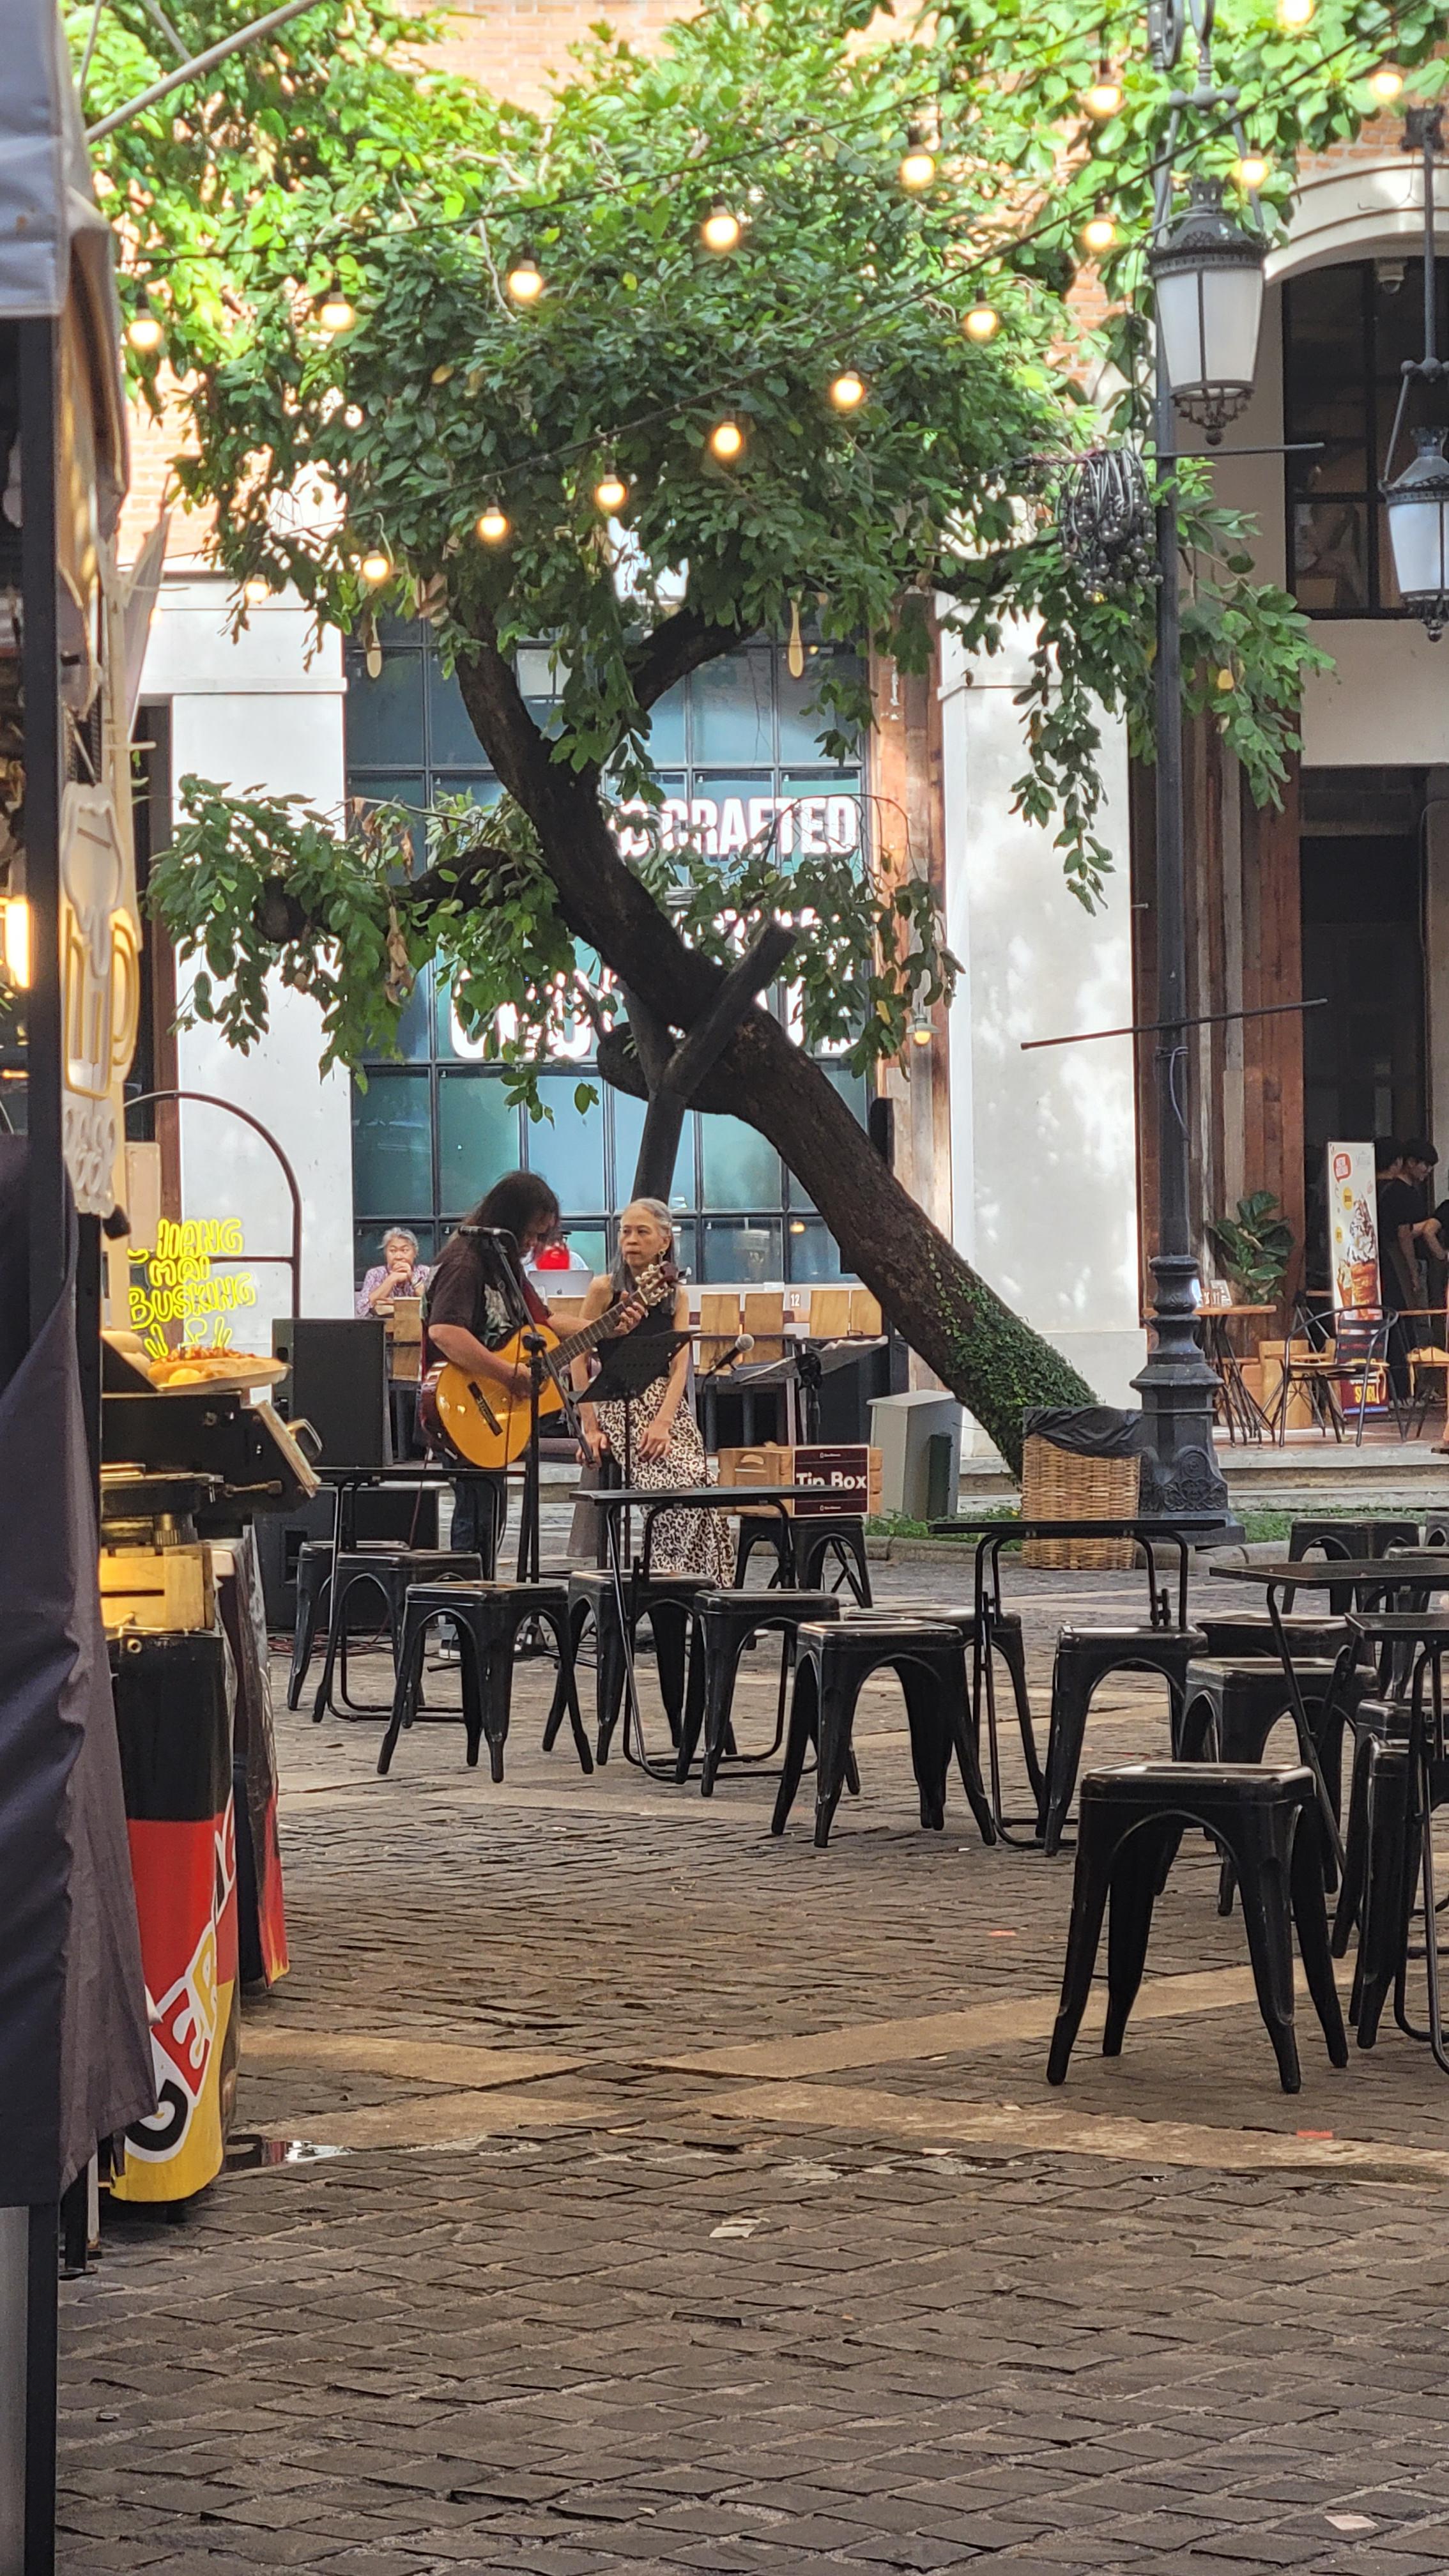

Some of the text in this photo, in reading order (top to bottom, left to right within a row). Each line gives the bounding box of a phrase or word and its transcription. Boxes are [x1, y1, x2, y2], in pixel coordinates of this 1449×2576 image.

[661, 797, 857, 855] CRAFTED
[149, 1256, 210, 1287] MAI
[128, 1273, 255, 1330] BUSKING
[790, 1294, 801, 1307] 12
[831, 1471, 867, 1490] Box
